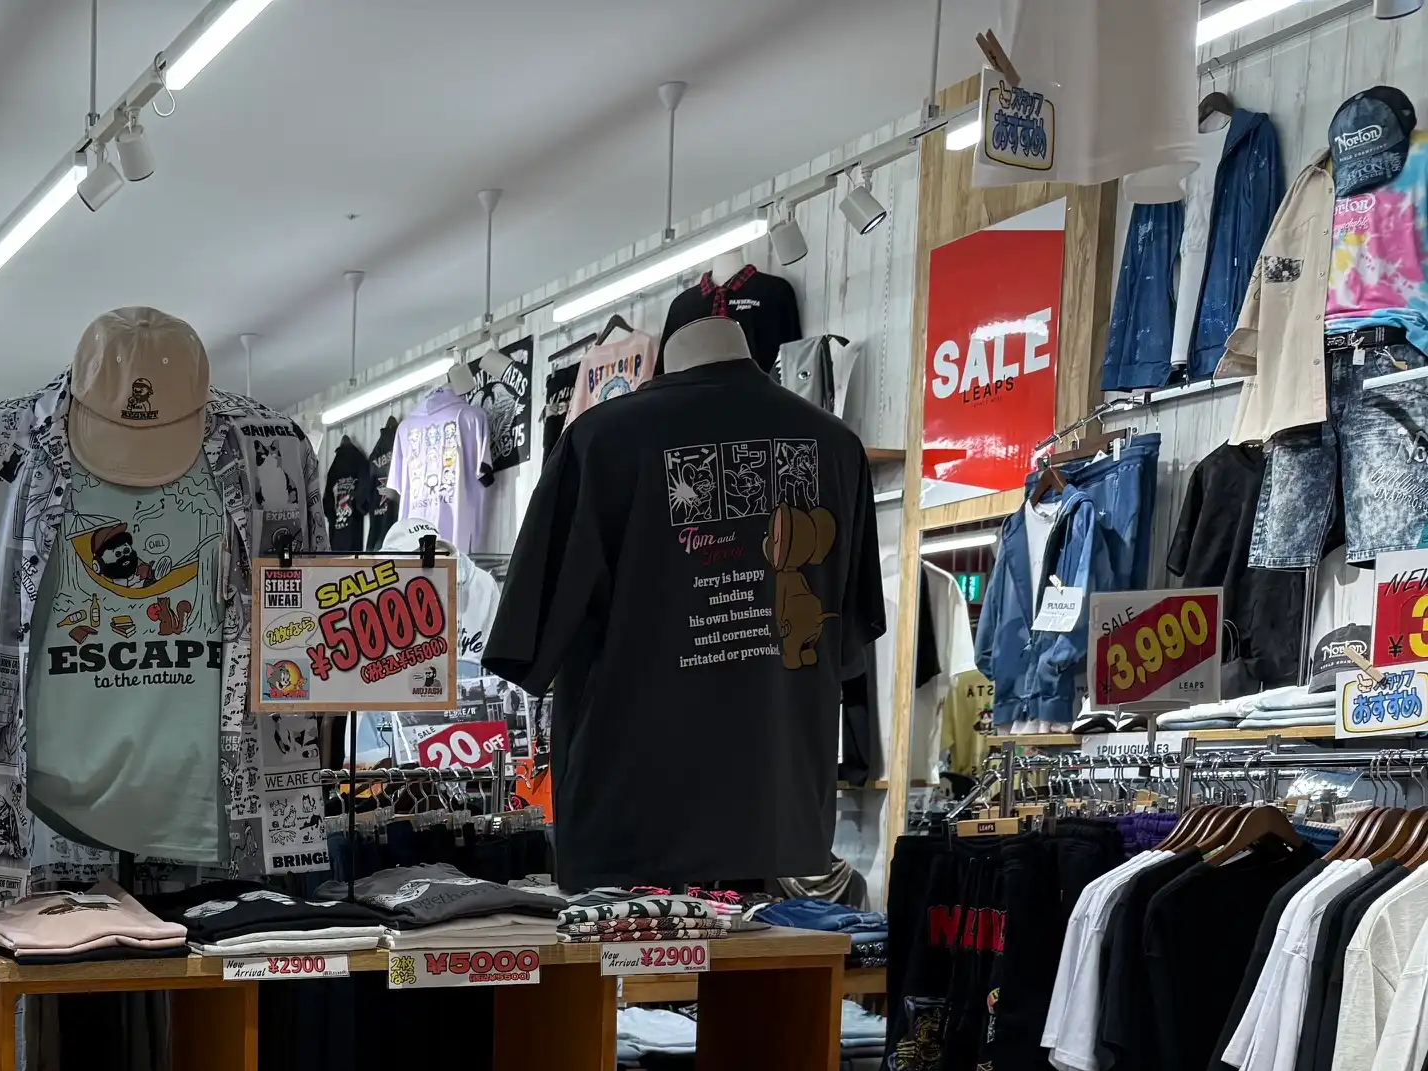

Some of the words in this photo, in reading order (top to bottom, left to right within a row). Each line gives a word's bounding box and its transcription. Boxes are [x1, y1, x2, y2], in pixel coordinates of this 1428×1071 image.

[993, 109, 1047, 159] おすすめ
[1335, 125, 1382, 153] Norton
[932, 307, 1052, 399] SALE
[589, 361, 618, 394] BETTY
[618, 354, 642, 378] BOOP
[963, 374, 1014, 404] LEAP'S
[149, 539, 165, 548] CHILL
[679, 527, 716, 554] Tom
[717, 532, 736, 544] and
[265, 571, 301, 579] VISION
[316, 560, 399, 609] SALE
[693, 574, 720, 588] Jerry
[722, 572, 731, 584] is
[732, 569, 765, 584] happy
[265, 580, 301, 592] STREET
[268, 594, 299, 607] WEAR
[709, 590, 754, 606] minding
[689, 615, 705, 628] his
[706, 612, 729, 625] own
[730, 607, 772, 622] business
[1101, 607, 1137, 637] SALE
[266, 617, 316, 646] 2枚なら
[306, 576, 445, 681] ¥5000
[694, 633, 721, 647] until
[722, 625, 772, 643] cornered,
[679, 650, 725, 668] irritated
[726, 649, 740, 660] or
[94, 674, 113, 688] to
[114, 672, 141, 687] the
[142, 670, 195, 685] nature
[1352, 688, 1423, 726] おすすめ
[418, 726, 436, 739] SALE
[427, 731, 481, 770] 20
[483, 734, 504, 753] OFF
[1096, 744, 1169, 756] 1PIU1UGUAE3
[265, 776, 284, 788] WE
[286, 775, 303, 787] ARE
[227, 960, 245, 970] New
[267, 956, 326, 974] ¥2900
[425, 950, 539, 975] ¥5000
[602, 951, 620, 960] New
[609, 957, 639, 968] Arrival
[640, 945, 706, 967] ¥2900
[234, 968, 266, 977] Arrival
[390, 970, 416, 984] なら
